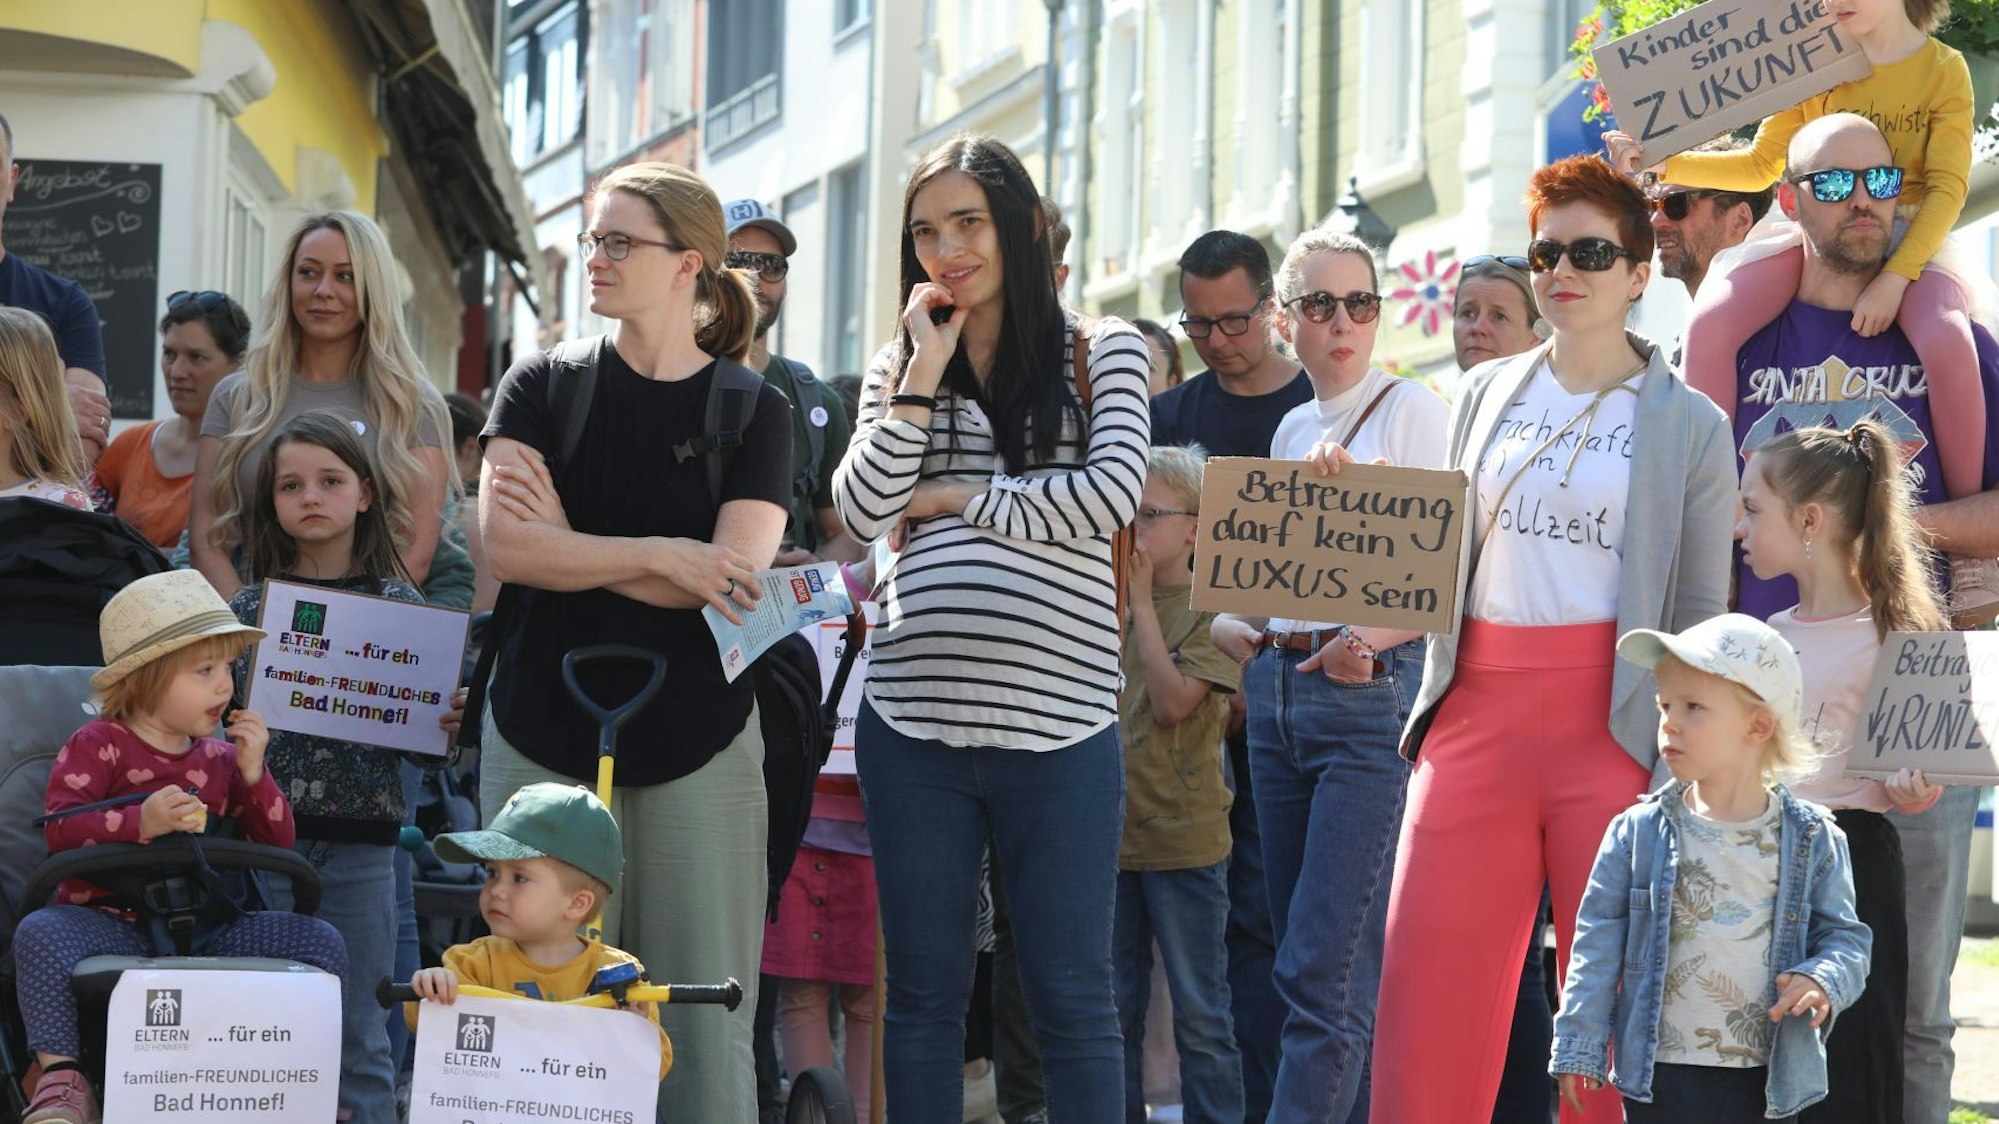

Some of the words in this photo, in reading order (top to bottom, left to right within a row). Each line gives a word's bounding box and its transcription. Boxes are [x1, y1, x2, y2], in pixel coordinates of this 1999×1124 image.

[1617, 7, 1741, 70] Kinder
[1691, 17, 1774, 71] sind
[1780, 0, 1831, 37] die
[1633, 21, 1848, 142] ZUKUNFT
[18, 163, 112, 200] Angebot
[1743, 365, 1828, 406] SANTA
[1841, 363, 1928, 400] CRUZ
[1237, 469, 1454, 552] Betreuung
[1212, 508, 1303, 547] darf
[1314, 515, 1395, 558] kein
[1209, 554, 1348, 599] LUXUS
[1361, 573, 1438, 613] sein
[280, 632, 331, 652] ELTERN
[362, 642, 391, 660] für
[391, 649, 420, 666] ein
[264, 665, 441, 706] familien-FREUNDLICHES
[289, 691, 329, 712] Bad
[332, 696, 410, 725] Honnef!
[135, 1029, 190, 1043] ELTERN
[228, 1026, 257, 1042] für
[261, 1026, 291, 1042] ein
[123, 1069, 319, 1085] familien-FREUNDLICHES
[444, 1052, 501, 1069] ELTERN
[541, 1058, 571, 1077] für
[575, 1061, 607, 1080] ein
[154, 1094, 194, 1112] Bad
[200, 1093, 285, 1112] Honnef!
[430, 1092, 634, 1124] familien-FREUNDLICHES
